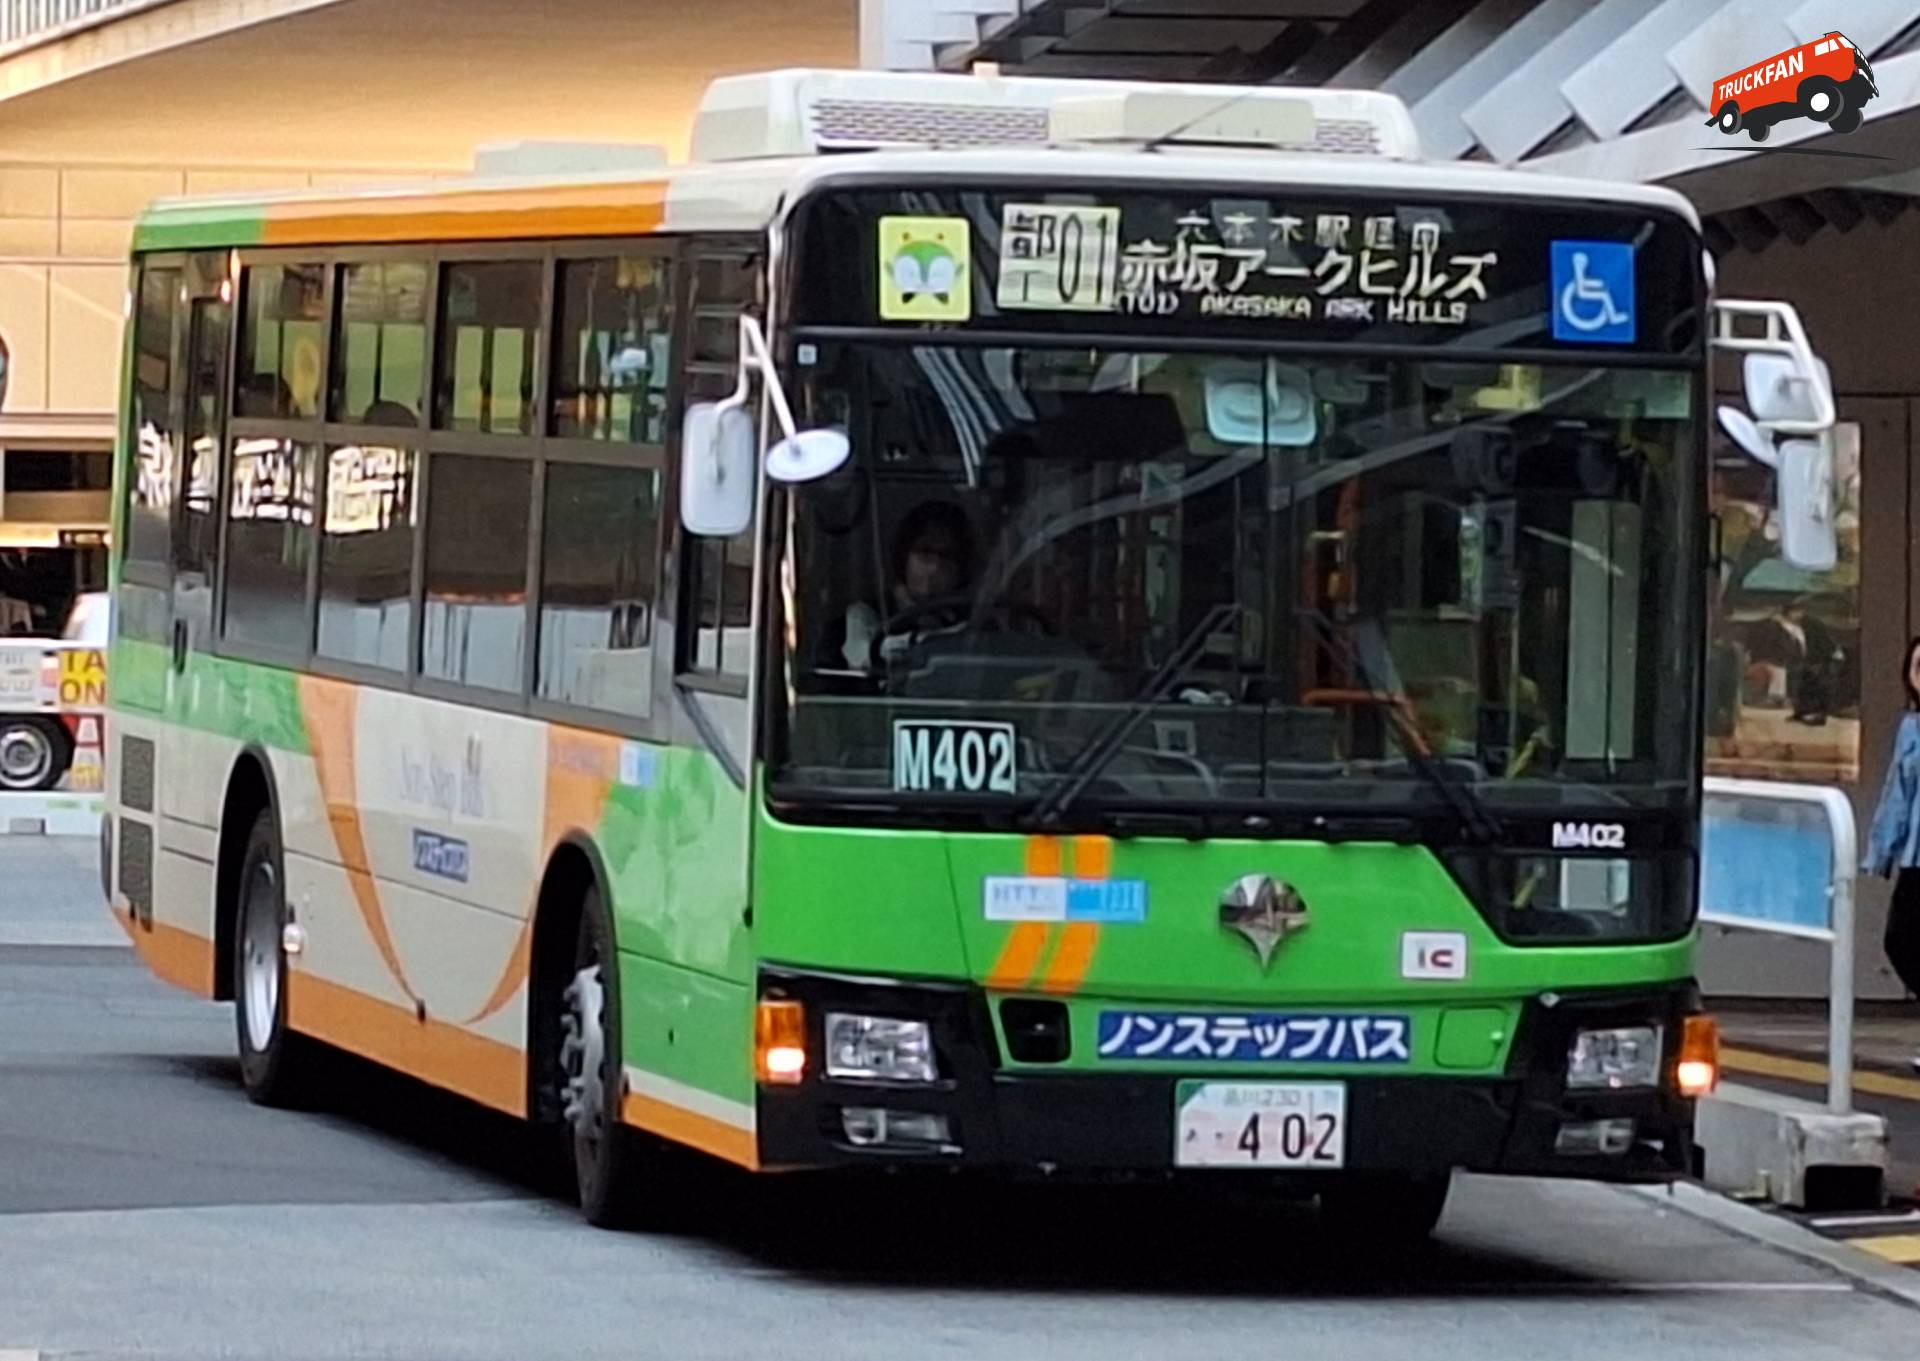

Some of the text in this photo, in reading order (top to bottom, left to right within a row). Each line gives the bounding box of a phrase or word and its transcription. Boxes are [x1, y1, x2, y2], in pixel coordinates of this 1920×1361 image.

[1121, 238, 1498, 301] 赤坂アークヒルズ
[1200, 294, 1312, 318] AKASAKA
[1387, 297, 1468, 323] HILLS
[900, 728, 1014, 791] M402
[1552, 822, 1626, 848] M402
[1099, 1014, 1410, 1060] ノンステップバス
